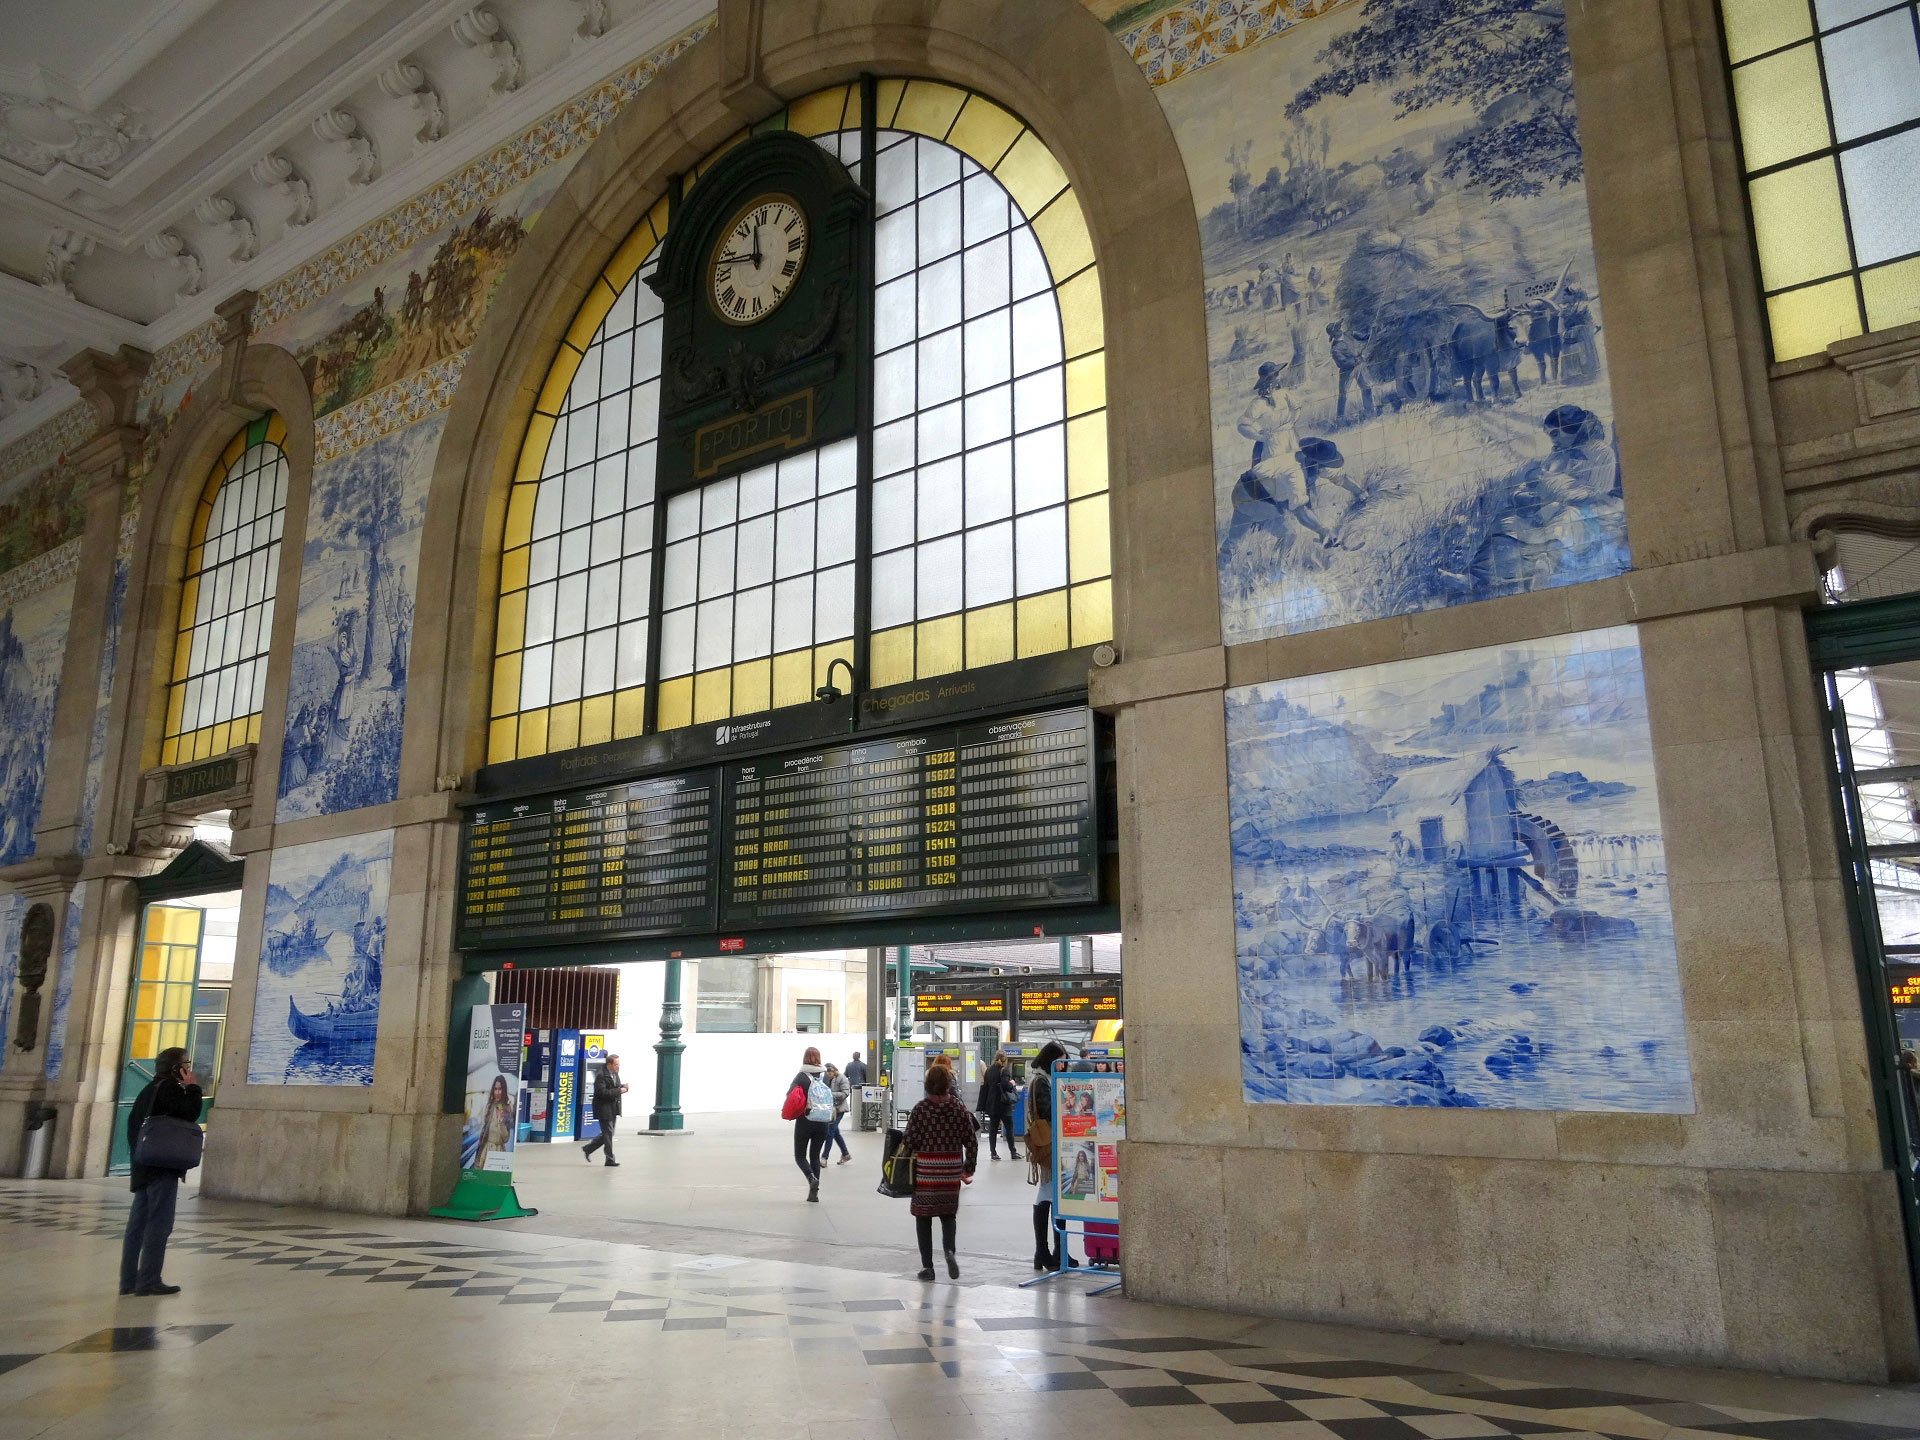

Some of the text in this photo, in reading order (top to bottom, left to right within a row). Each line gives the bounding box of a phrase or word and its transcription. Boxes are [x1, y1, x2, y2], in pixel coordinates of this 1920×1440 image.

[713, 405, 792, 457] PORTO
[862, 682, 976, 714] Chegadas Arrivals
[731, 720, 772, 734] Infraestruturas
[731, 730, 760, 742] de Portugal
[988, 720, 1036, 735] observações
[896, 738, 926, 748] comboio
[560, 753, 598, 770] Partidas
[784, 755, 823, 768] procedência
[926, 751, 955, 766] 15222
[172, 764, 234, 796] ENTRADA
[926, 768, 955, 782] 15622
[586, 792, 608, 801] comboio
[736, 812, 760, 824] 12H30
[926, 785, 955, 800] 15528
[764, 824, 784, 837] OVAR
[858, 815, 862, 825] 2
[868, 809, 902, 824] SUBURB
[926, 802, 955, 816] 15818
[734, 844, 758, 856] 12H45
[764, 840, 788, 852] BRAGA
[868, 826, 902, 840] SUBURB
[926, 820, 955, 834] 15224
[490, 848, 512, 859] AVEIRO
[734, 838, 955, 871] 13H00 PENAFIEL 5 SUBURB 15414
[468, 877, 485, 888] 12H15
[562, 866, 586, 877] SUBURB
[603, 860, 623, 872] 15221
[734, 875, 758, 887] 13H15
[762, 870, 808, 884] GUIMARAES
[868, 861, 901, 874] SUBURB
[926, 855, 955, 868] 15160
[487, 887, 520, 899] GUIMARAES
[562, 880, 586, 891] SUBURB
[602, 875, 622, 886] 15161
[857, 881, 862, 891] 3
[868, 877, 902, 890] SUBURB
[926, 872, 955, 885] 15624
[600, 905, 622, 915] 15223
[556, 1072, 568, 1133] EXCHANGE
